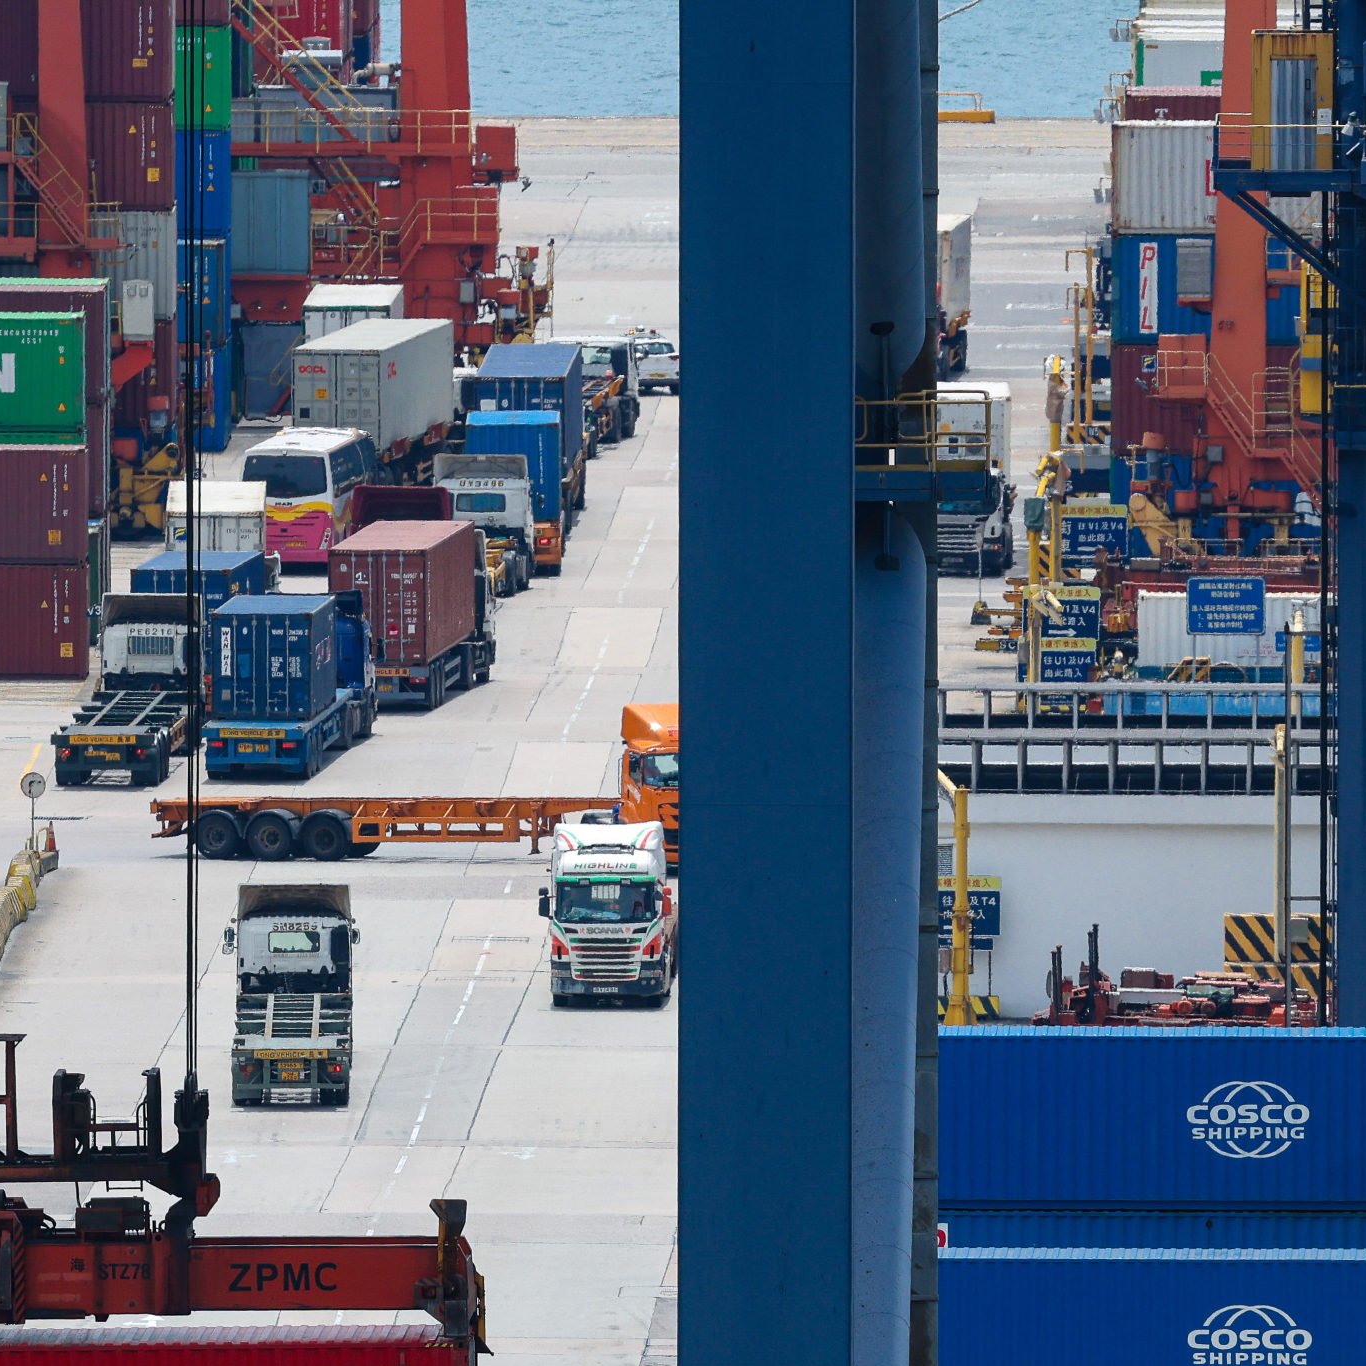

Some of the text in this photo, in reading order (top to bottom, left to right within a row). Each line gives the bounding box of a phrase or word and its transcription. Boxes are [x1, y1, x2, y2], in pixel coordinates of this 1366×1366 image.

[573, 862, 639, 871] HIGHLINE
[585, 926, 625, 935] SCANIA
[1186, 1103, 1311, 1125] COSCO
[1192, 1127, 1306, 1140] SHIPPING
[228, 1261, 340, 1293] ZPMC
[1186, 1328, 1313, 1351] COSCO
[1192, 1352, 1308, 1366] SHIPPING
